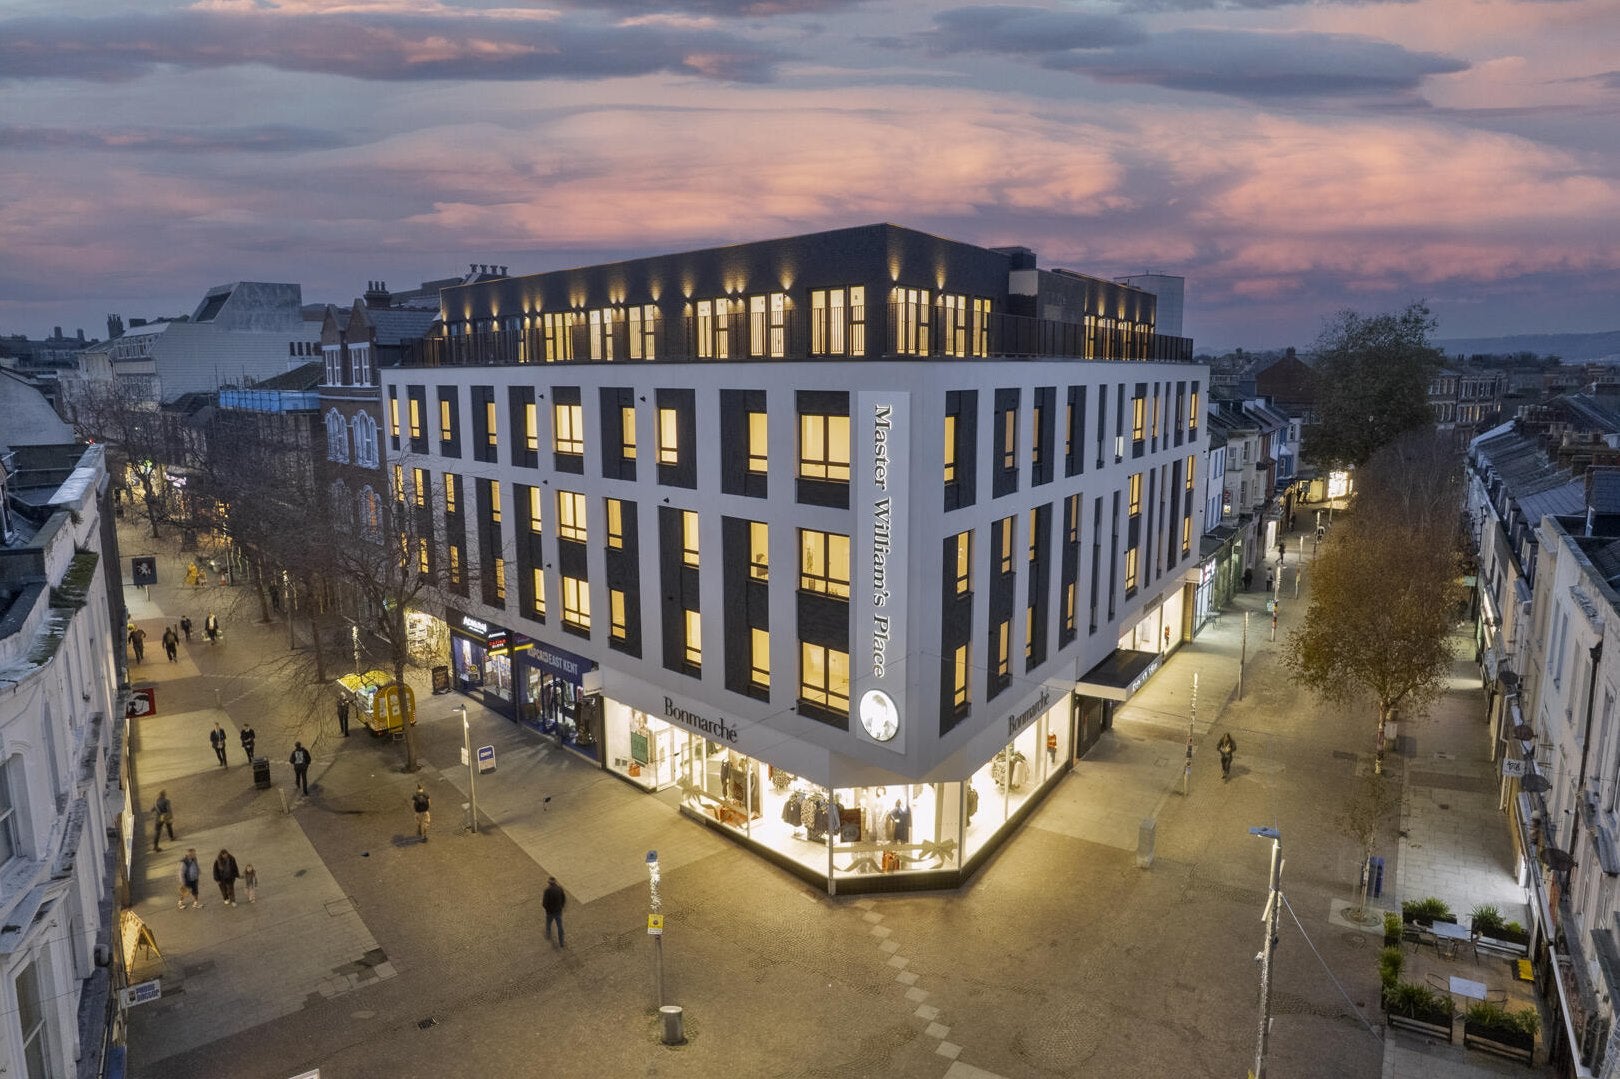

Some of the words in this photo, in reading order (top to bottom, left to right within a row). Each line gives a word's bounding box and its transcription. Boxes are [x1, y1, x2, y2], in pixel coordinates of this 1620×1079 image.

[873, 403, 891, 491] Master
[872, 497, 891, 608] William's
[548, 653, 563, 669] EAST
[562, 658, 578, 676] KENT
[872, 613, 890, 679] Place
[663, 695, 738, 744] Bonmarché
